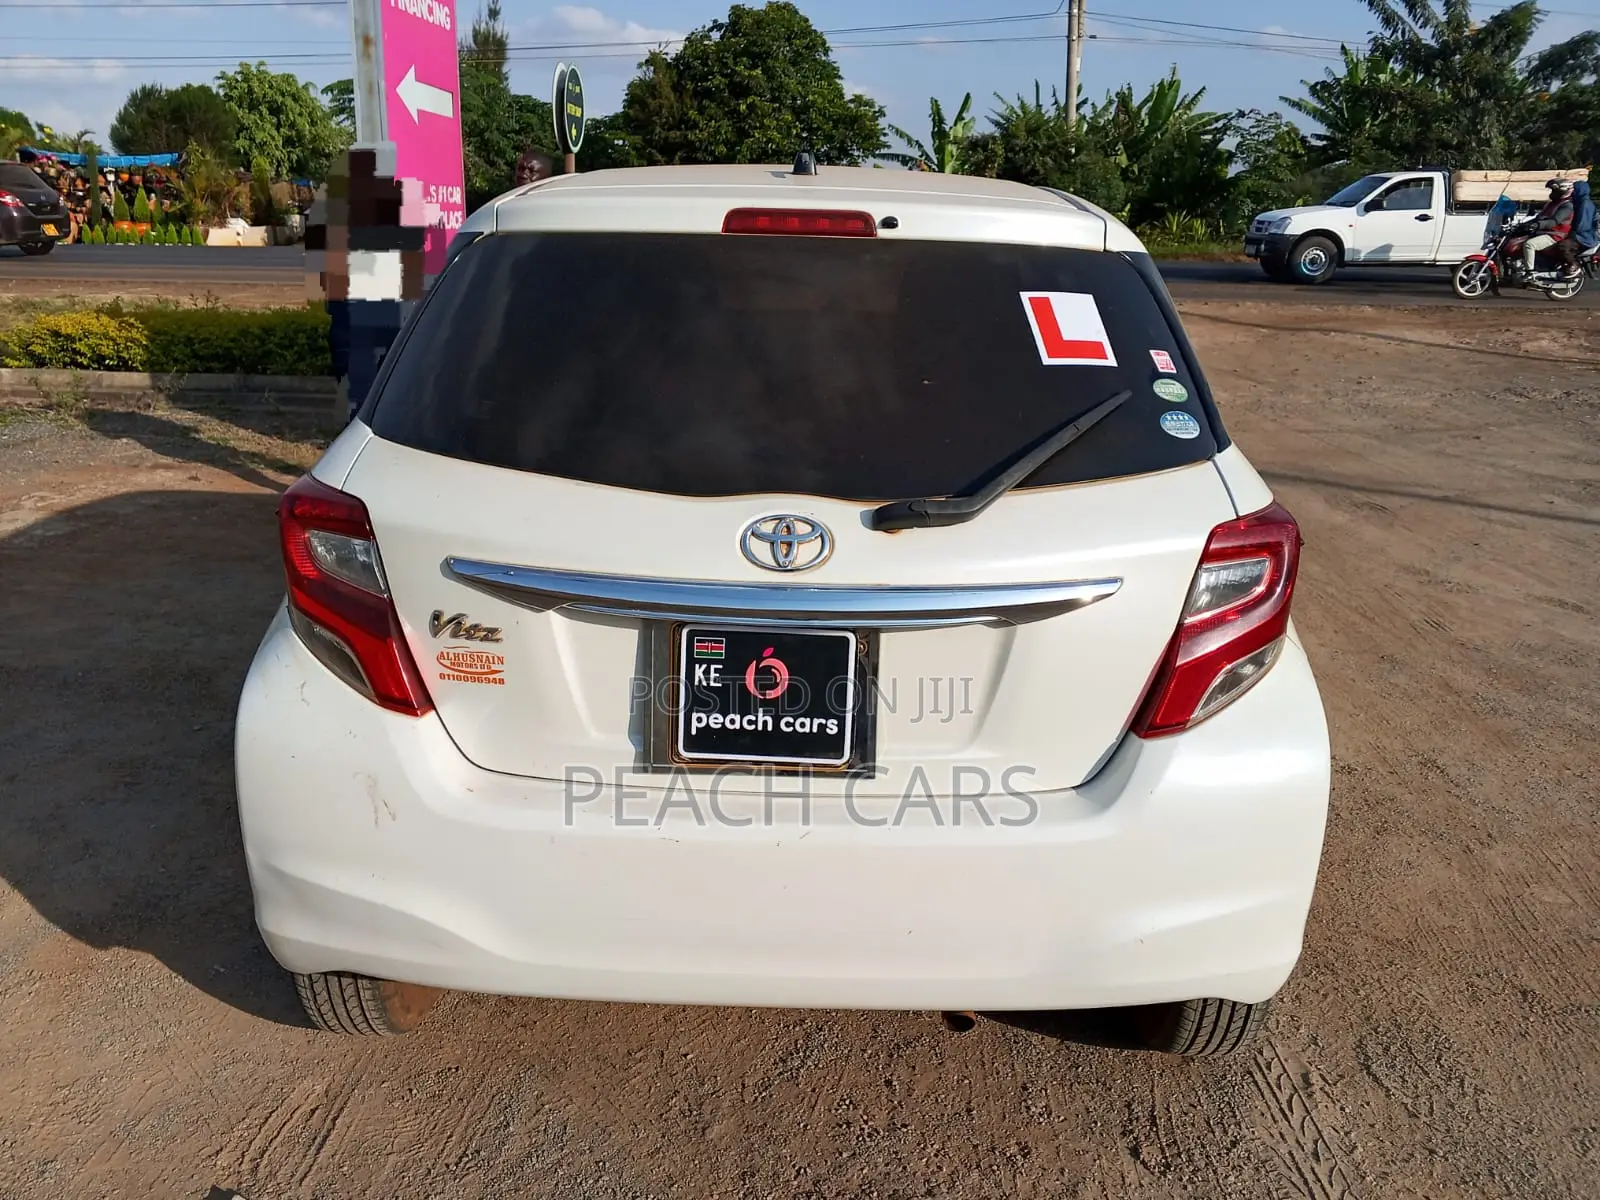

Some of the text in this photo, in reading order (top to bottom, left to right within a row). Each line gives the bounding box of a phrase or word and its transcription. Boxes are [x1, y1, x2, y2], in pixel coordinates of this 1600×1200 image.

[447, 185, 461, 205] CAR
[1028, 297, 1108, 360] L
[439, 651, 504, 665] ALHUSNAIN
[694, 663, 723, 687] KE
[690, 708, 839, 736] peach cars
